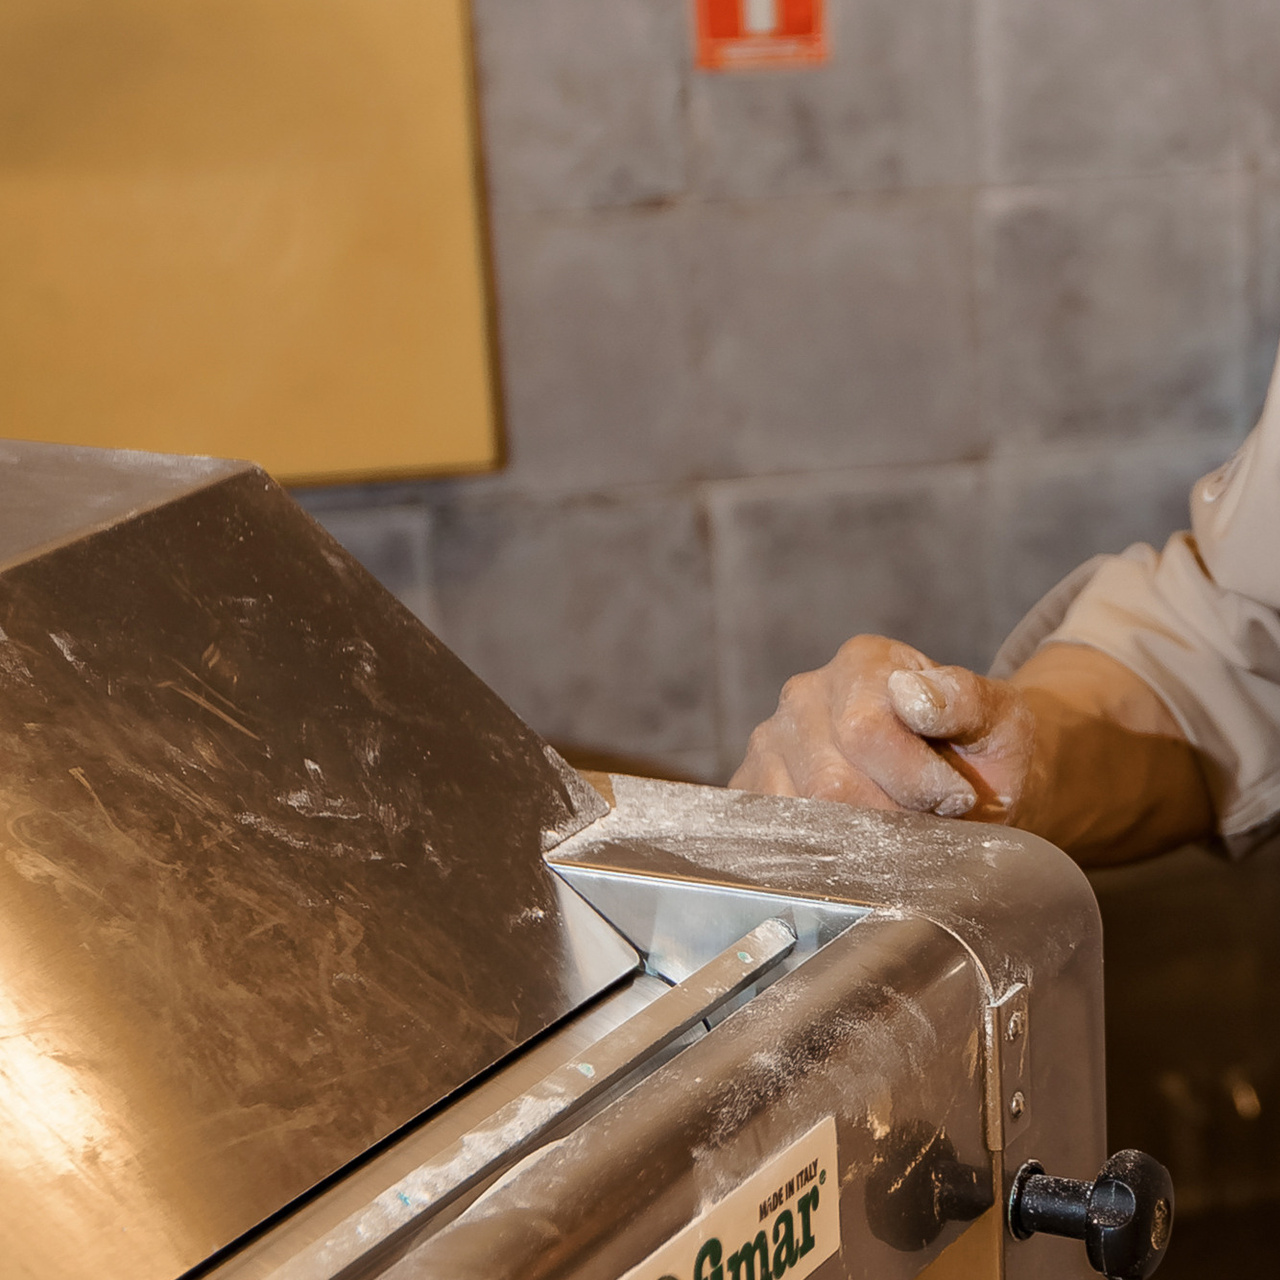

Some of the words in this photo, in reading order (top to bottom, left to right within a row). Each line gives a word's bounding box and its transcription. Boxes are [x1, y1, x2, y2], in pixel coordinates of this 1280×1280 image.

[759, 1186, 784, 1223] MADE
[785, 1176, 795, 1201] IN
[796, 1158, 819, 1191] ITALY
